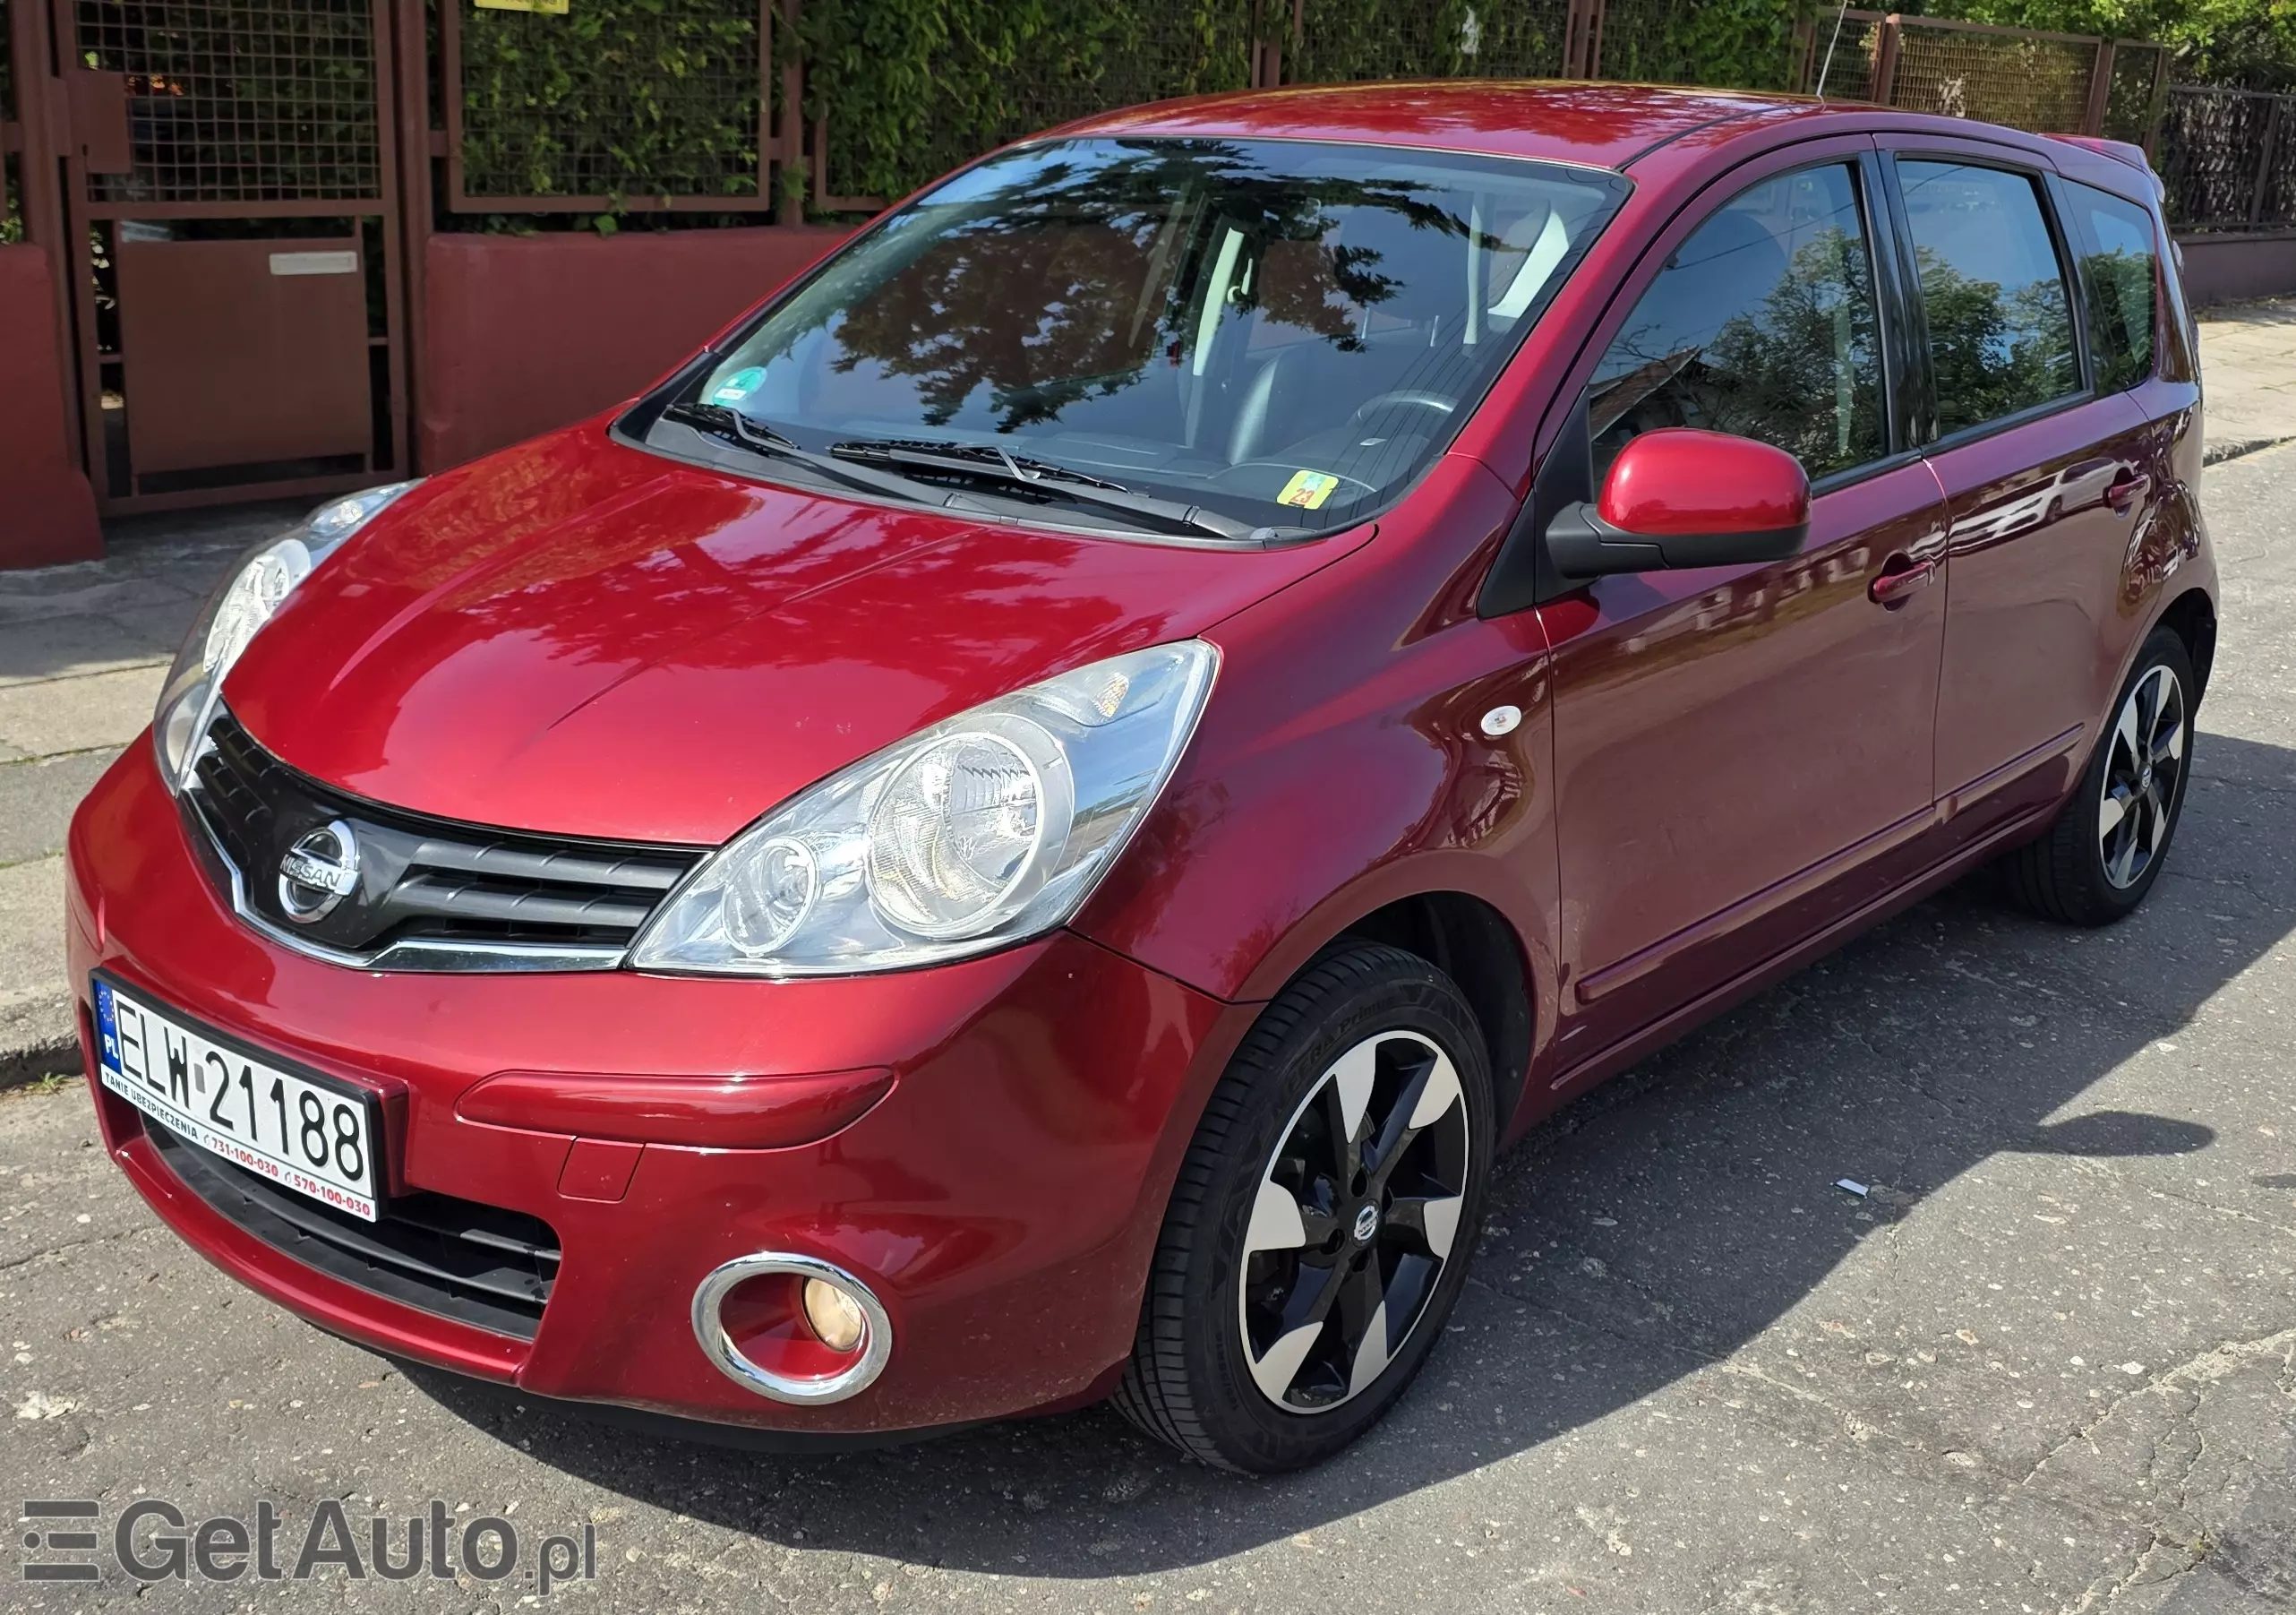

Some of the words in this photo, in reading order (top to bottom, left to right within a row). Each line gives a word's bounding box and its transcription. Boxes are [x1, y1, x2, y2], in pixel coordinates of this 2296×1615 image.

[279, 855, 342, 888] NISSAN
[103, 1034, 119, 1060] PL
[116, 999, 190, 1111] ELW
[205, 1051, 364, 1181] 21188
[105, 1071, 129, 1095] TANIE
[131, 1088, 199, 1139] UBEZPIECZENIA
[211, 1137, 278, 1178] 731-100-030
[294, 1175, 371, 1216] 570-100-030
